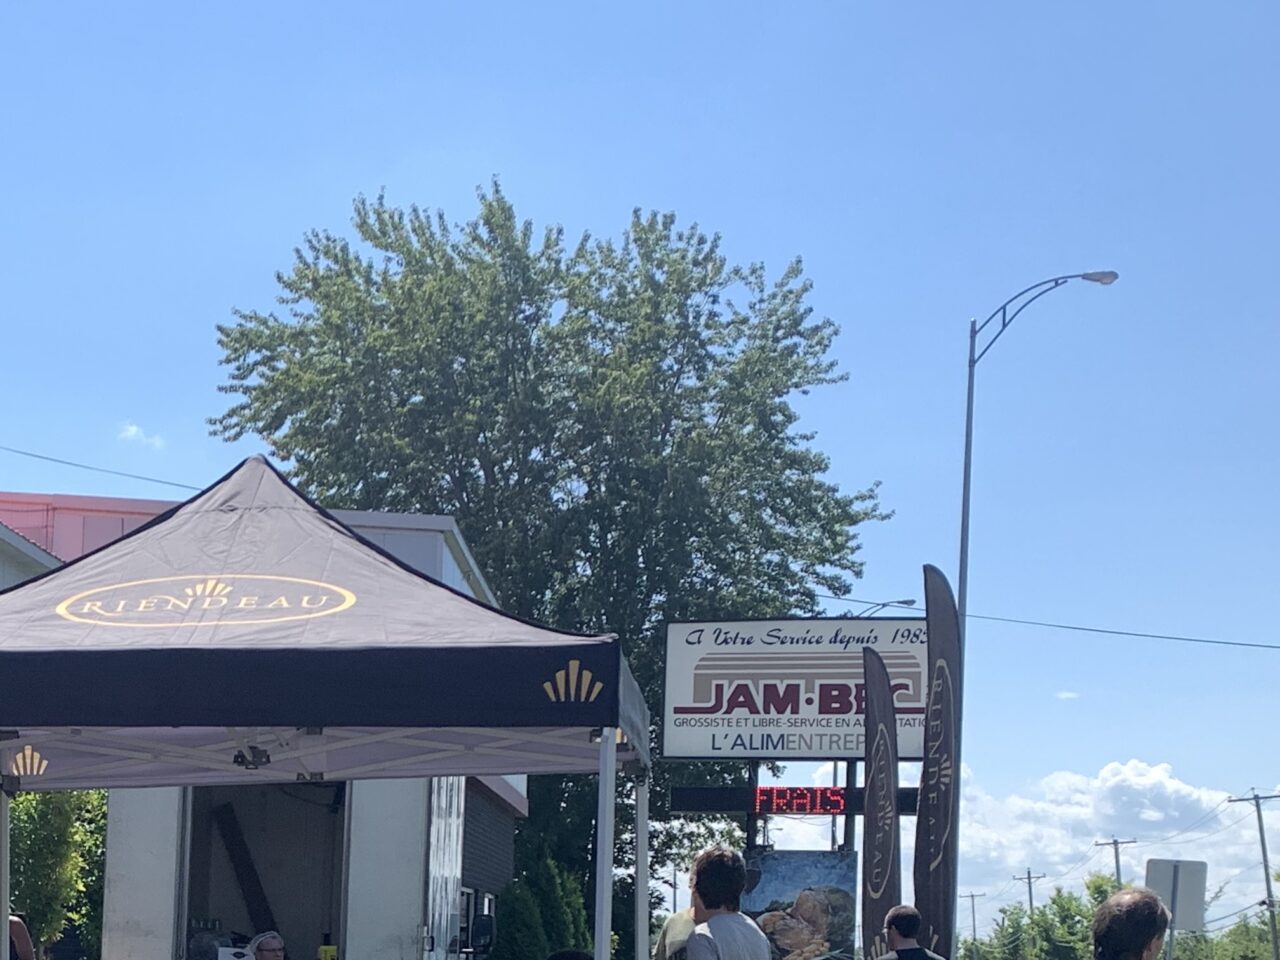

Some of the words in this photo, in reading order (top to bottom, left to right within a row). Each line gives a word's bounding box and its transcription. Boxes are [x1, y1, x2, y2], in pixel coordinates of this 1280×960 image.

[82, 595, 329, 616] RIENDEAU
[712, 627, 755, 646] Votre
[760, 628, 824, 645] Service
[828, 627, 878, 650] depuis
[673, 717, 733, 728] GROSSISTE
[735, 717, 751, 728] ET
[752, 717, 833, 728] LIBRE-SERVICE
[835, 717, 851, 728] EN
[753, 785, 845, 814] FRAIS
